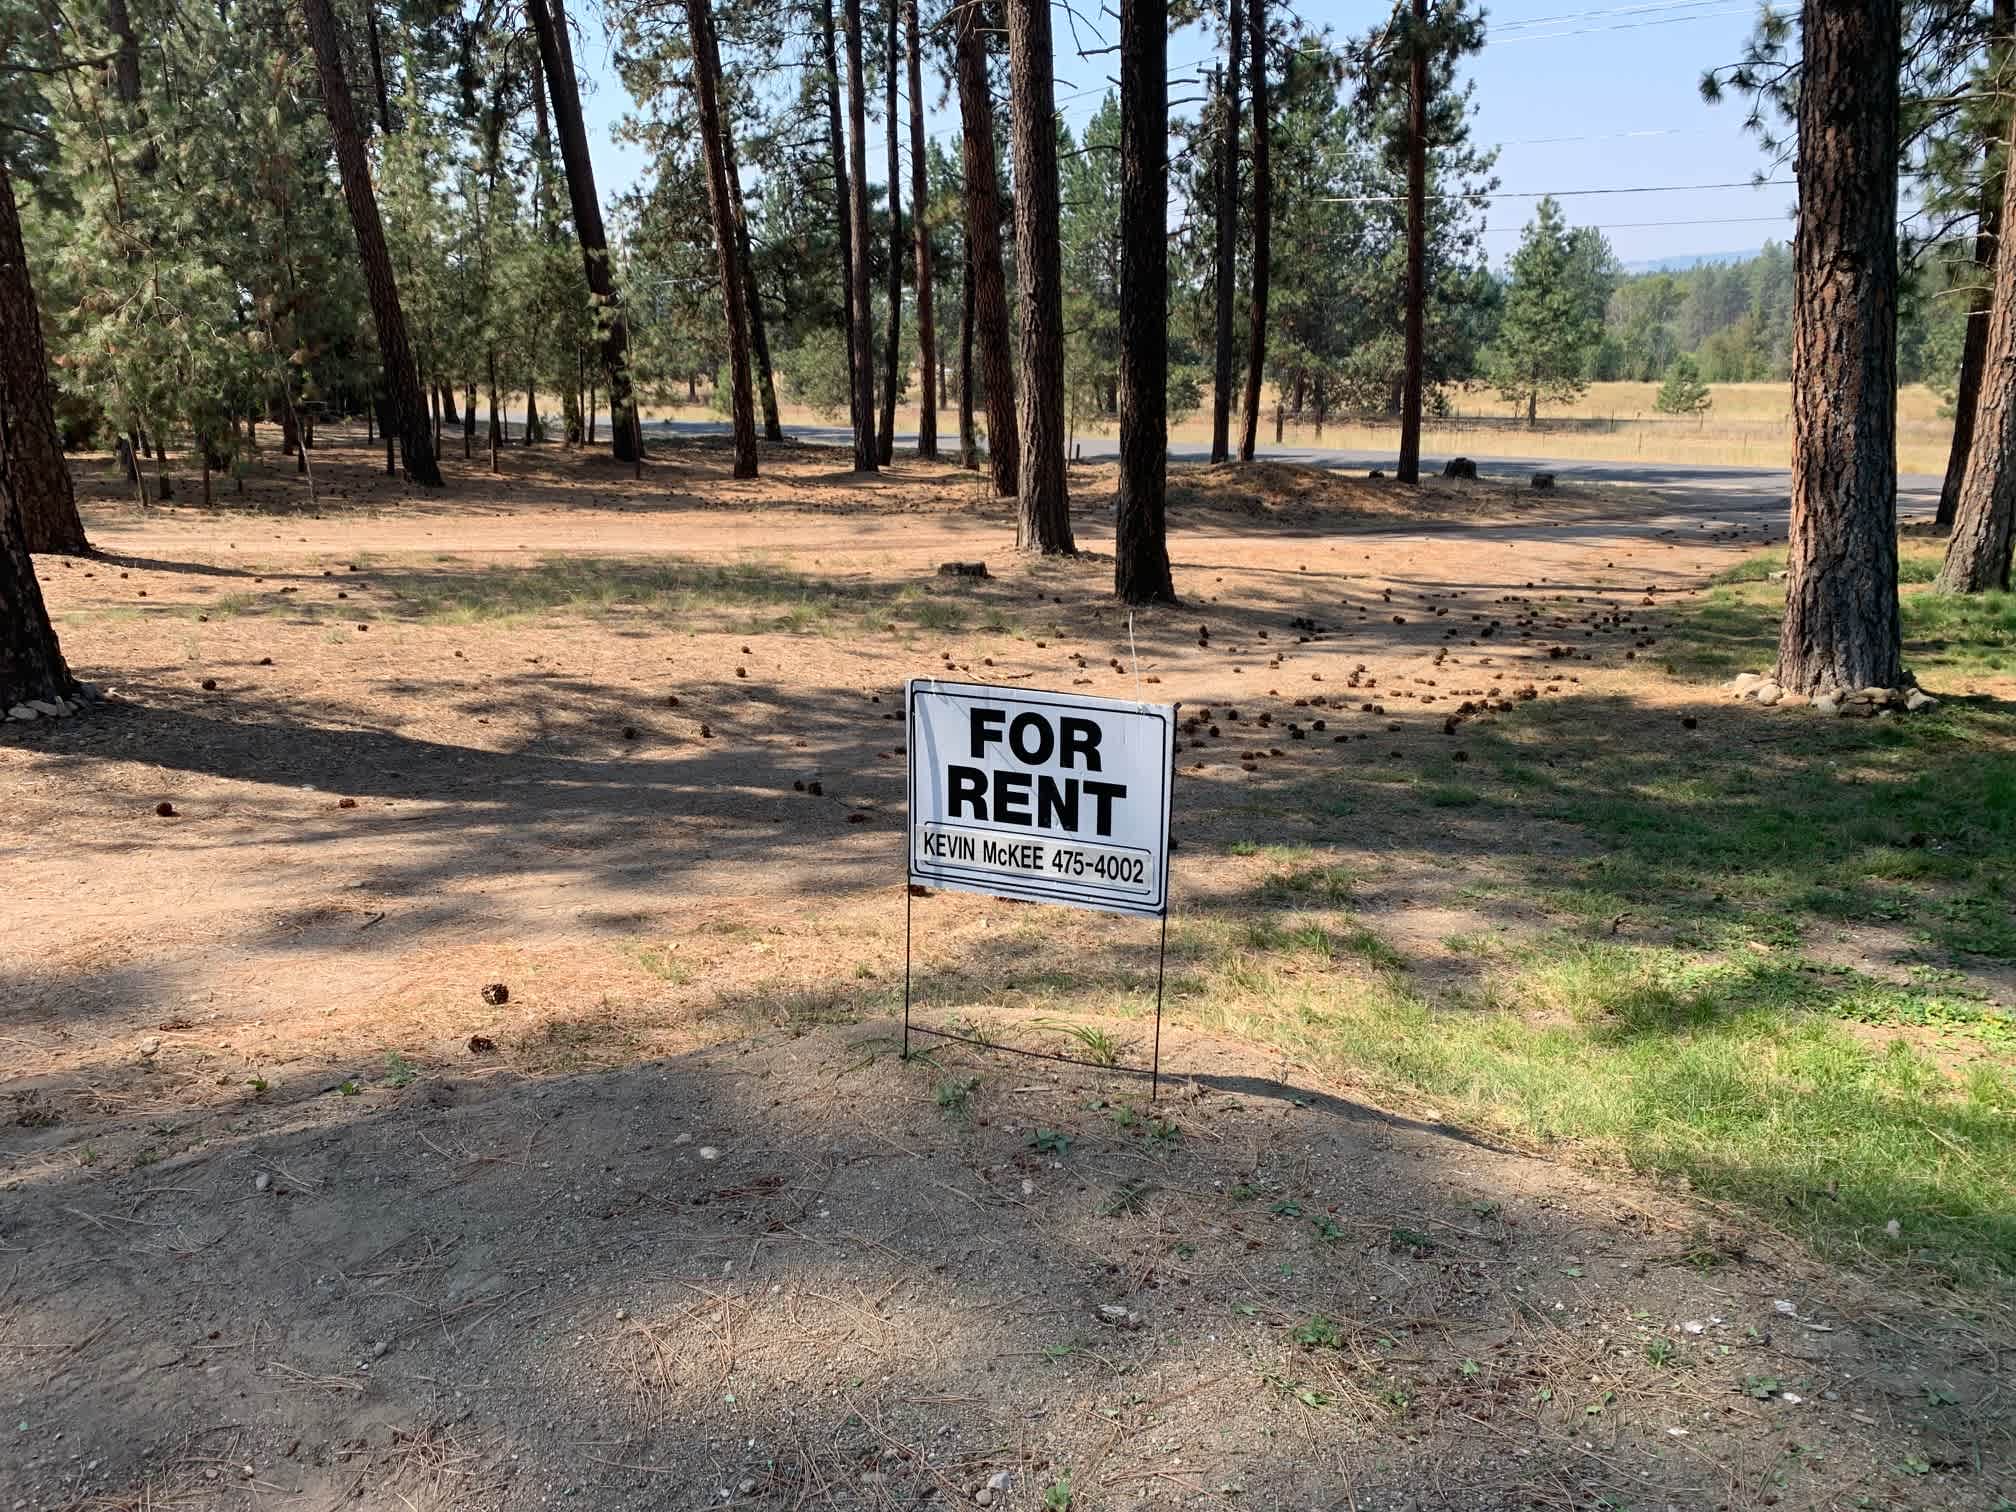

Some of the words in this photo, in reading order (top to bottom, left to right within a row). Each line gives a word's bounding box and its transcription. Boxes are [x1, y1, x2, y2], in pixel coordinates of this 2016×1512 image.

[970, 707, 1102, 772] FOR
[947, 764, 1127, 836] RENT
[924, 831, 975, 861] KEVIN
[983, 840, 1044, 870] McKEE
[1052, 849, 1144, 883] 475-4002
